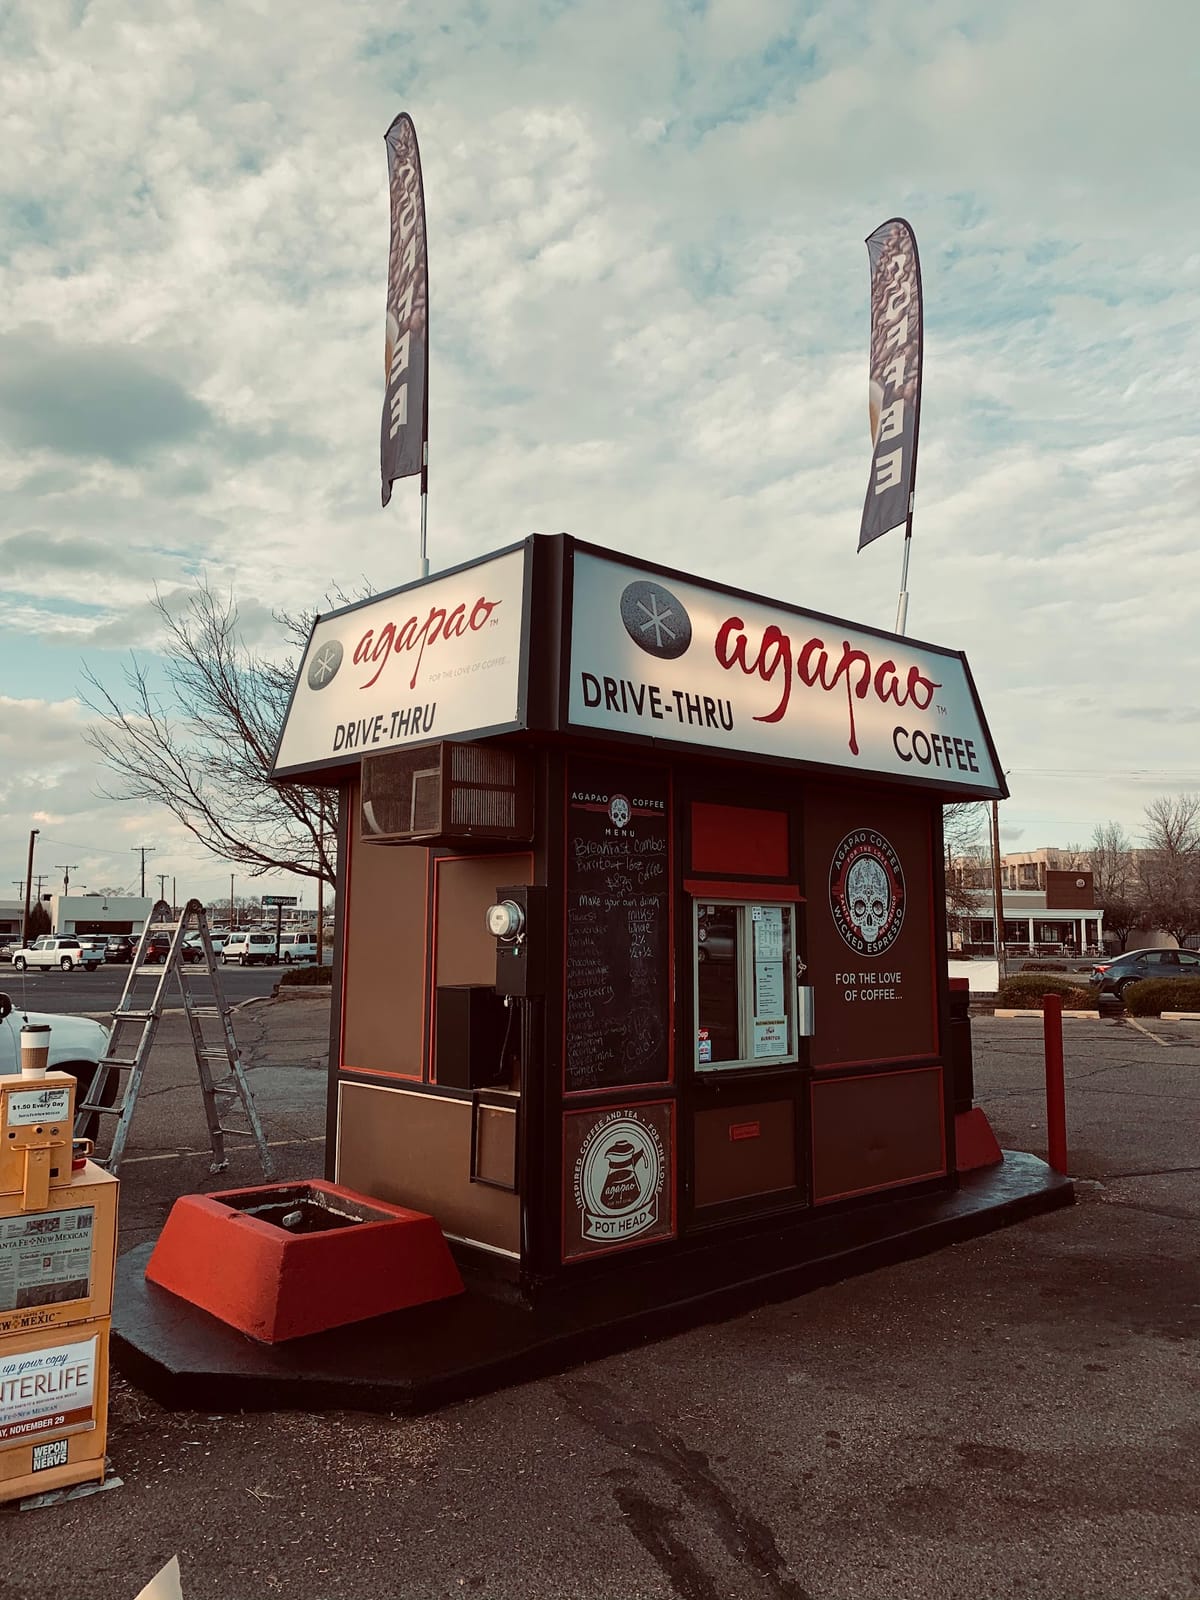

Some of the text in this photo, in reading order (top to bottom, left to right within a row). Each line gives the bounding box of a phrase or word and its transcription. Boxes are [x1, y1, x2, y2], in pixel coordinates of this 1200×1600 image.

[353, 596, 503, 690] agapao
[714, 616, 943, 756] agapao
[581, 671, 734, 732] DRIVE-THRU
[333, 702, 437, 751] DRIVE-THRU
[892, 726, 980, 773] COFFEE
[571, 791, 664, 809] AGAPAO COFFEE
[605, 828, 635, 838] MENU
[575, 838, 631, 856] Breakfast
[835, 832, 900, 874] AGAPAO COFFEE
[576, 858, 611, 873] Burrito
[605, 898, 620, 913] your
[834, 905, 903, 953] WICKED ESPRESSO
[835, 972, 902, 985] FOR THE LOVE
[844, 988, 903, 1002] OF COFFEE...
[12, 1103, 31, 1111] $1.50
[573, 1110, 638, 1209] INSPIRED COFFEE AND TEA
[647, 1123, 665, 1193] FOR THE LOVE
[605, 1183, 636, 1200] agapao
[595, 1212, 647, 1233] POT HEAD
[2, 1353, 69, 1376] up your copy
[9, 1418, 53, 1434] NOVEMBER
[54, 1415, 65, 1425] 29
